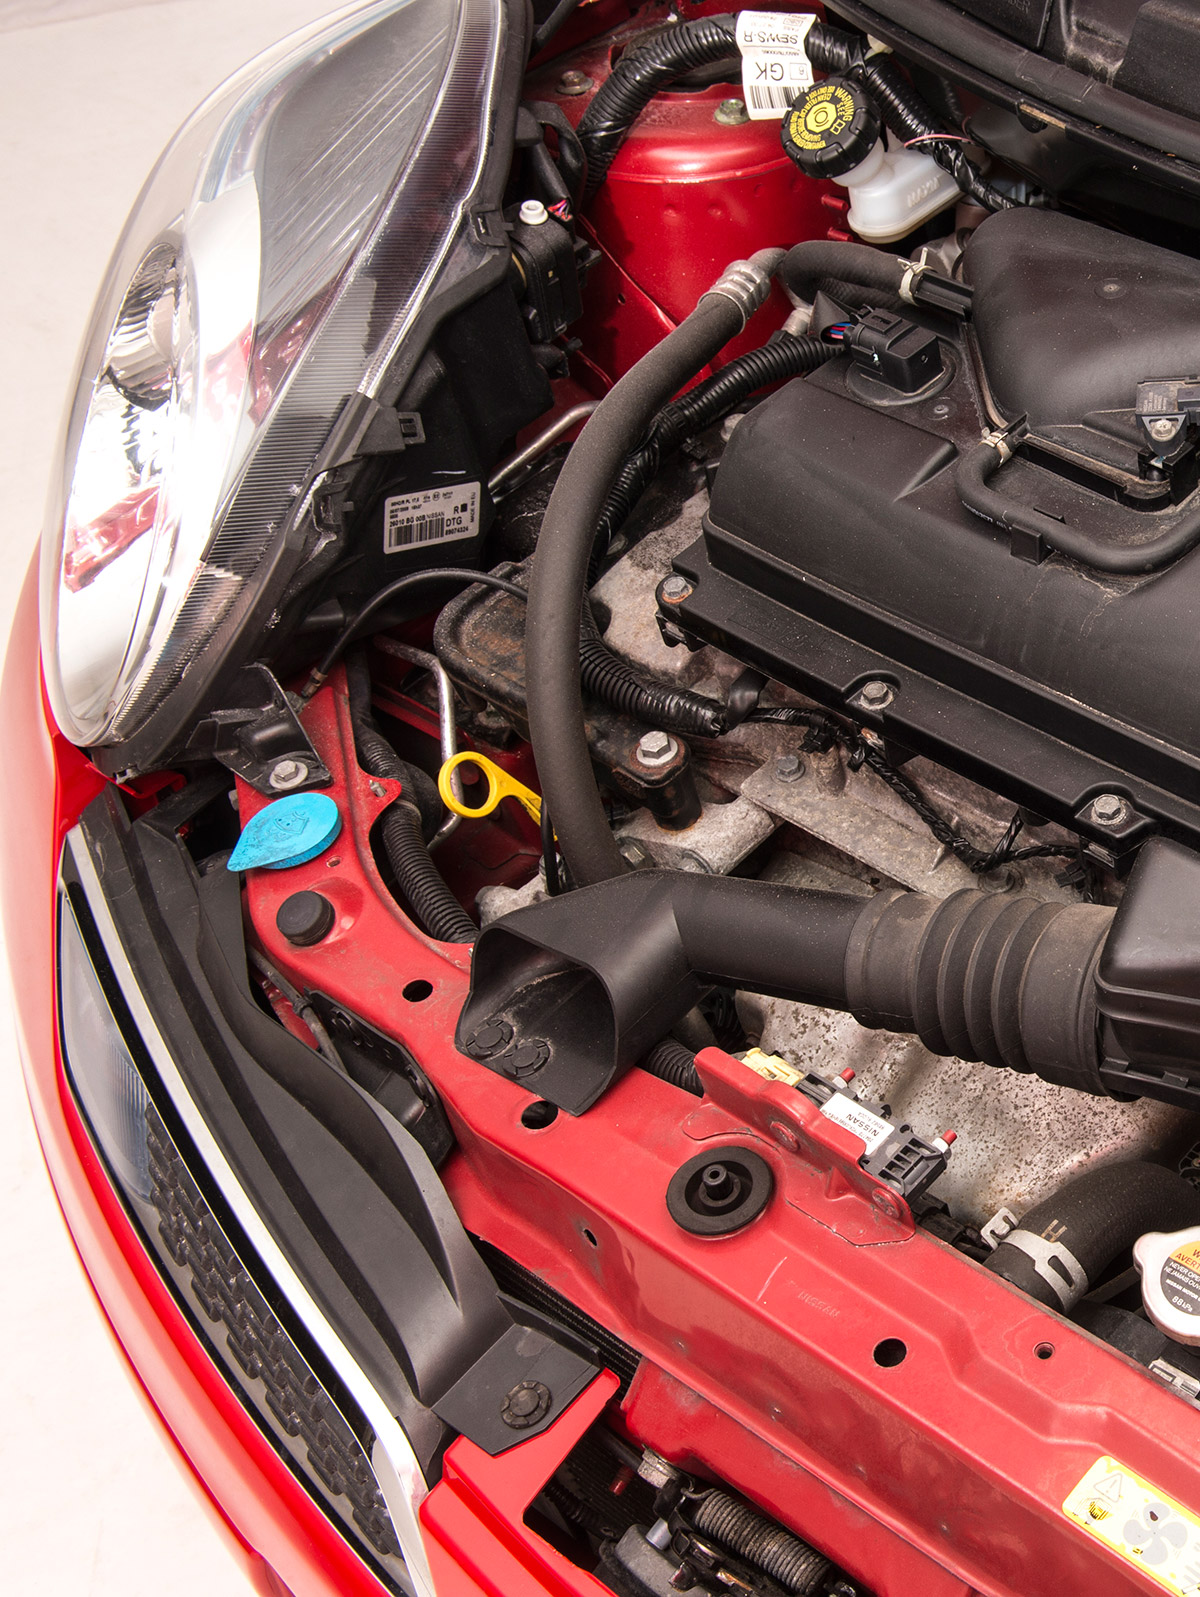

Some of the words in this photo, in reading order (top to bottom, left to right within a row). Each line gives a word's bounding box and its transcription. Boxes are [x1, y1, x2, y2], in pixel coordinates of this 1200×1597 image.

[743, 31, 798, 45] SEWS-R
[755, 62, 784, 81] GK
[834, 87, 854, 122] WARNING
[836, 102, 844, 116] SEE
[454, 506, 459, 514] R
[446, 517, 462, 527] DTG
[846, 1114, 880, 1136] NISSAN
[1164, 1266, 1173, 1274] NE
[1170, 1262, 1189, 1274] NEVER
[798, 1291, 840, 1318] NISSAN
